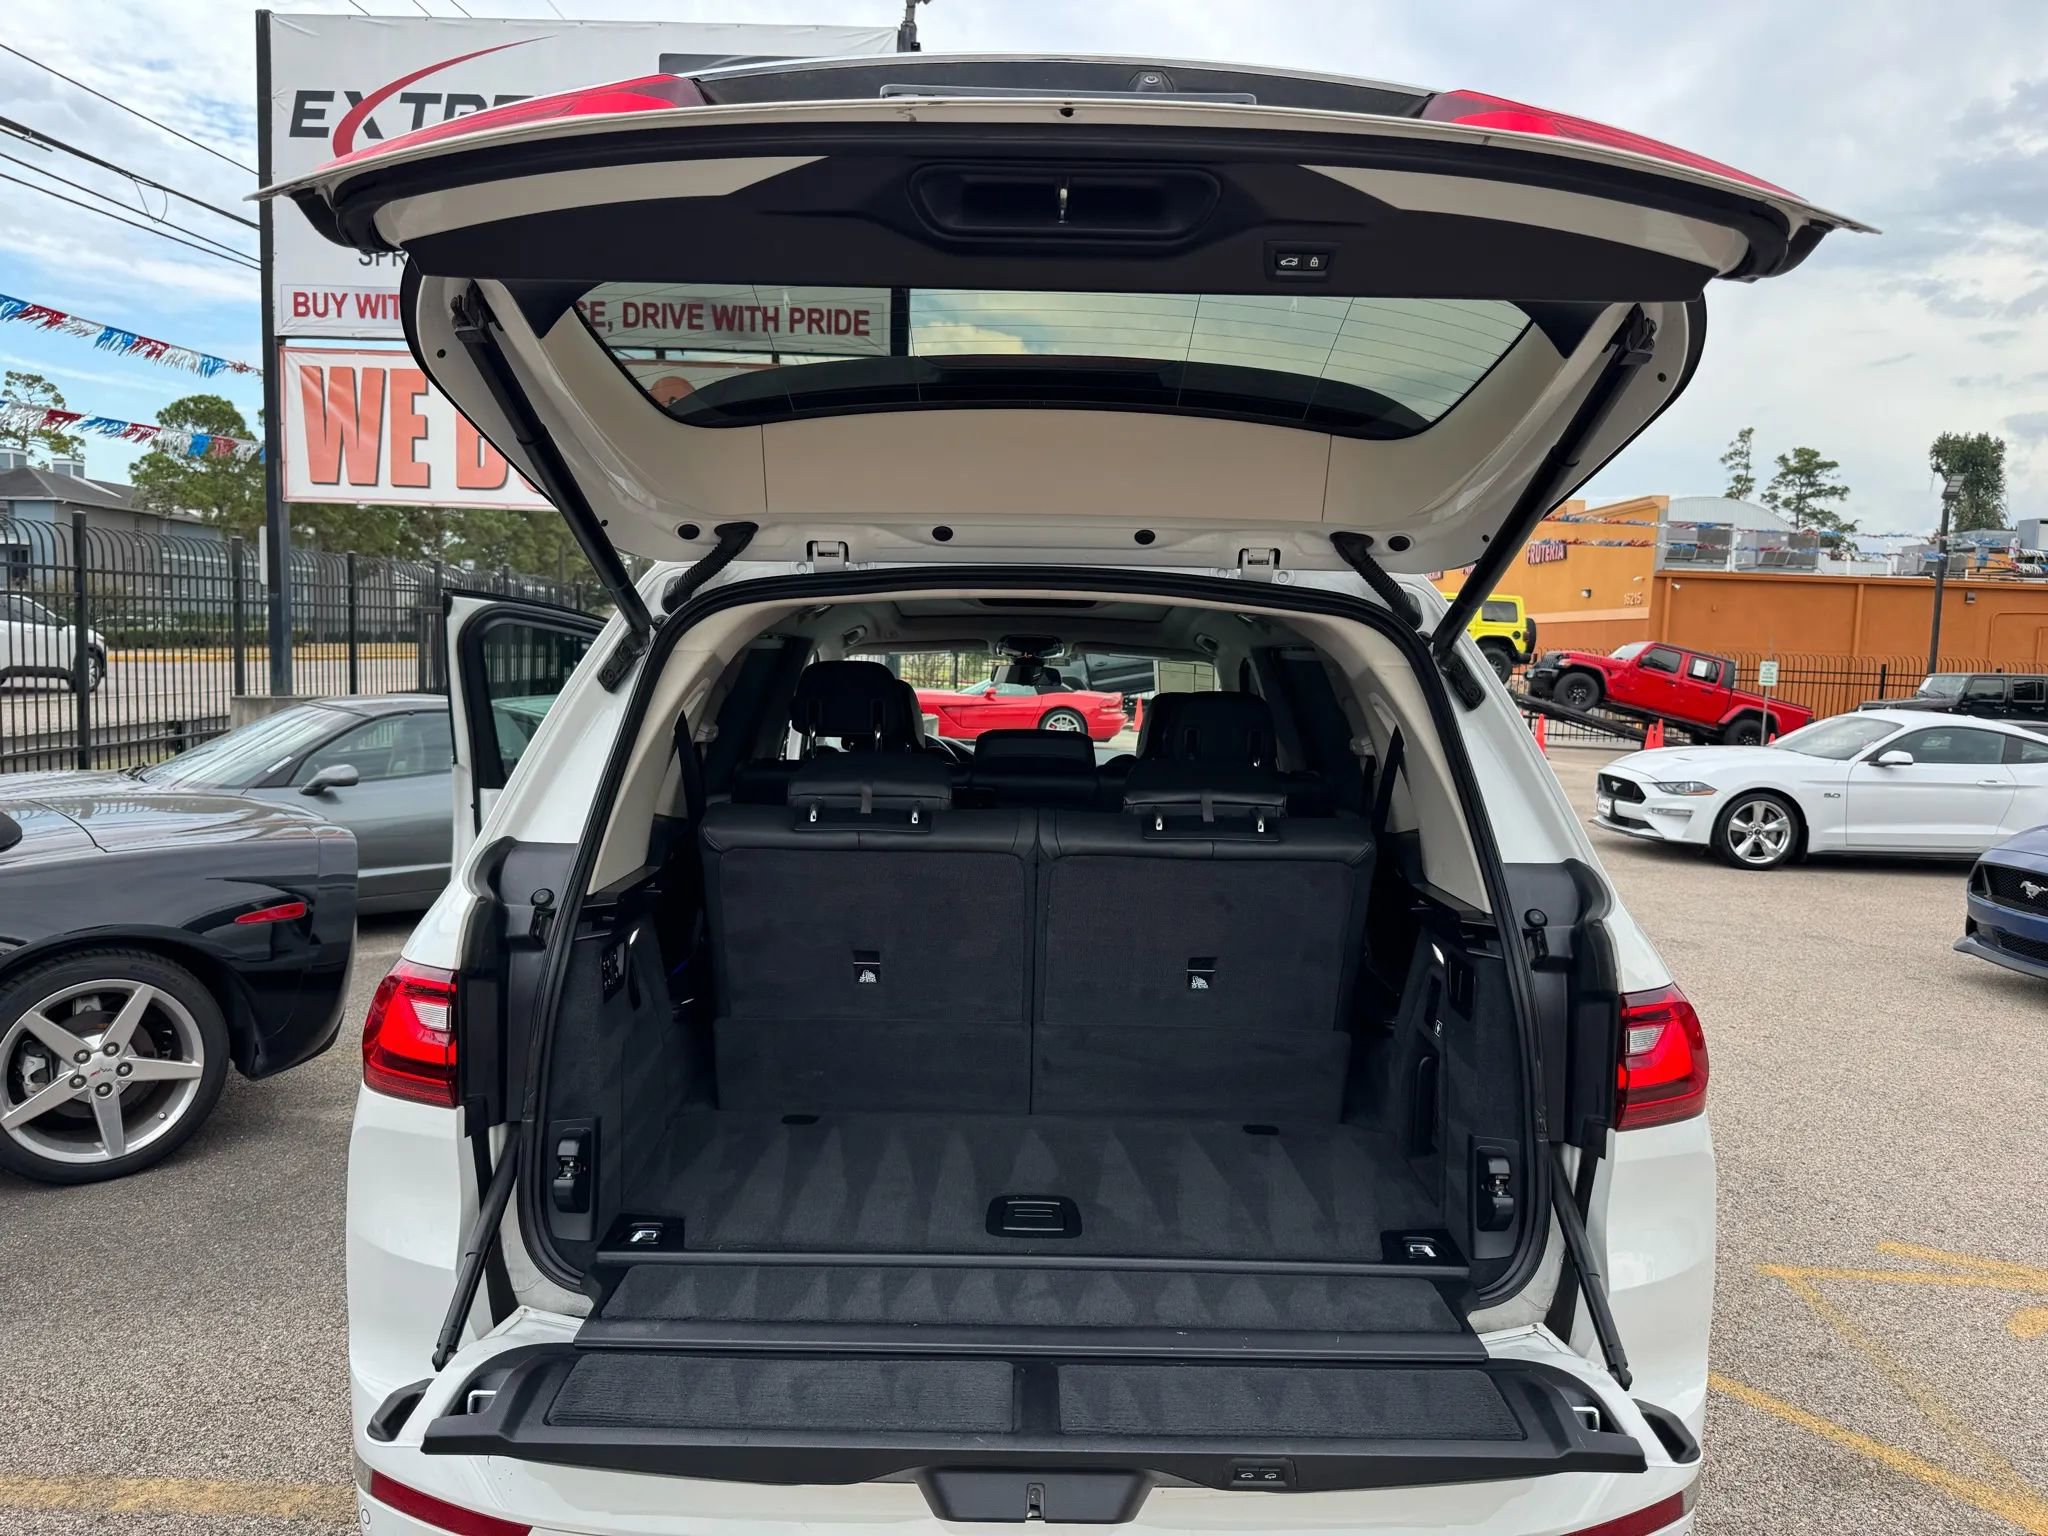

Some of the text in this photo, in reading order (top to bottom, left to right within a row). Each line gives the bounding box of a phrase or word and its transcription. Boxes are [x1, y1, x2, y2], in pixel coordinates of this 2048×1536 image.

[289, 90, 536, 144] EXT
[293, 291, 348, 318] BUY
[623, 301, 704, 330] DRIVE
[711, 304, 779, 333] WITH
[789, 307, 870, 336] PRIDE
[299, 365, 430, 488] WE
